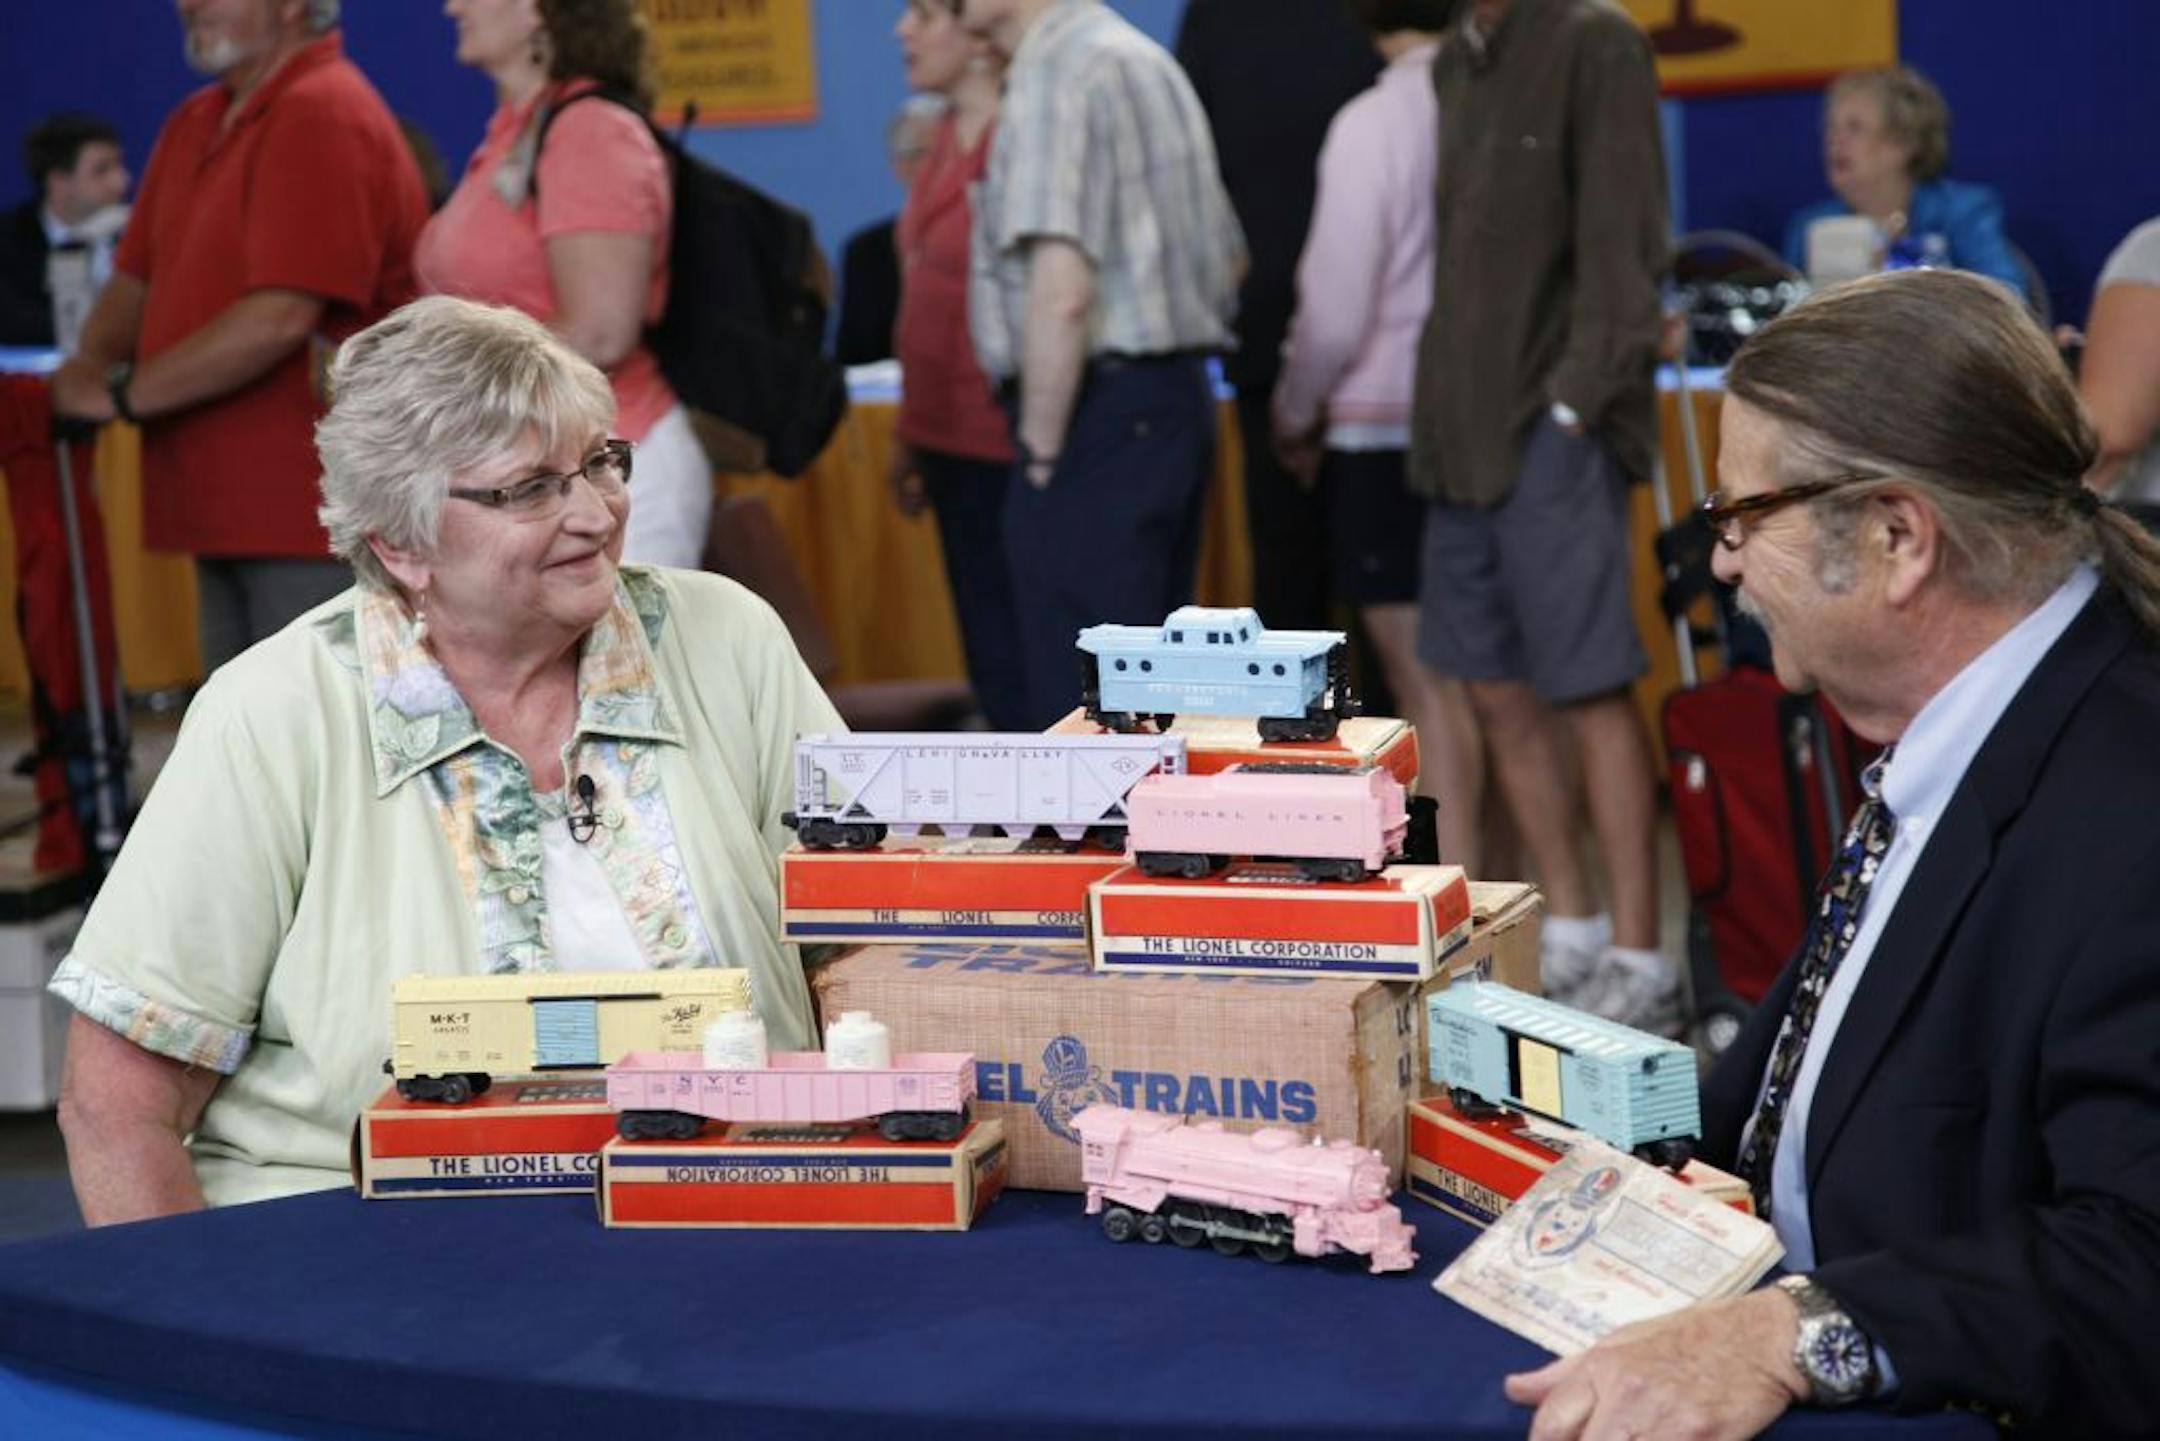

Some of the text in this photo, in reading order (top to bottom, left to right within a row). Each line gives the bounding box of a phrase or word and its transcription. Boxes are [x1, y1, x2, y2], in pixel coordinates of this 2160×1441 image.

[872, 911, 899, 923] THE
[942, 911, 994, 924] LIONEL
[1142, 937, 1377, 960] THE LIONEL CORPORATION
[1111, 1070, 1317, 1124] TRAINS
[430, 1157, 471, 1175] THE
[484, 1156, 564, 1174] LIONEL
[667, 1167, 890, 1182] THE LIONEL CORPORATION
[1438, 1168, 1459, 1194] THE
[1463, 1180, 1503, 1214] LIONEL
